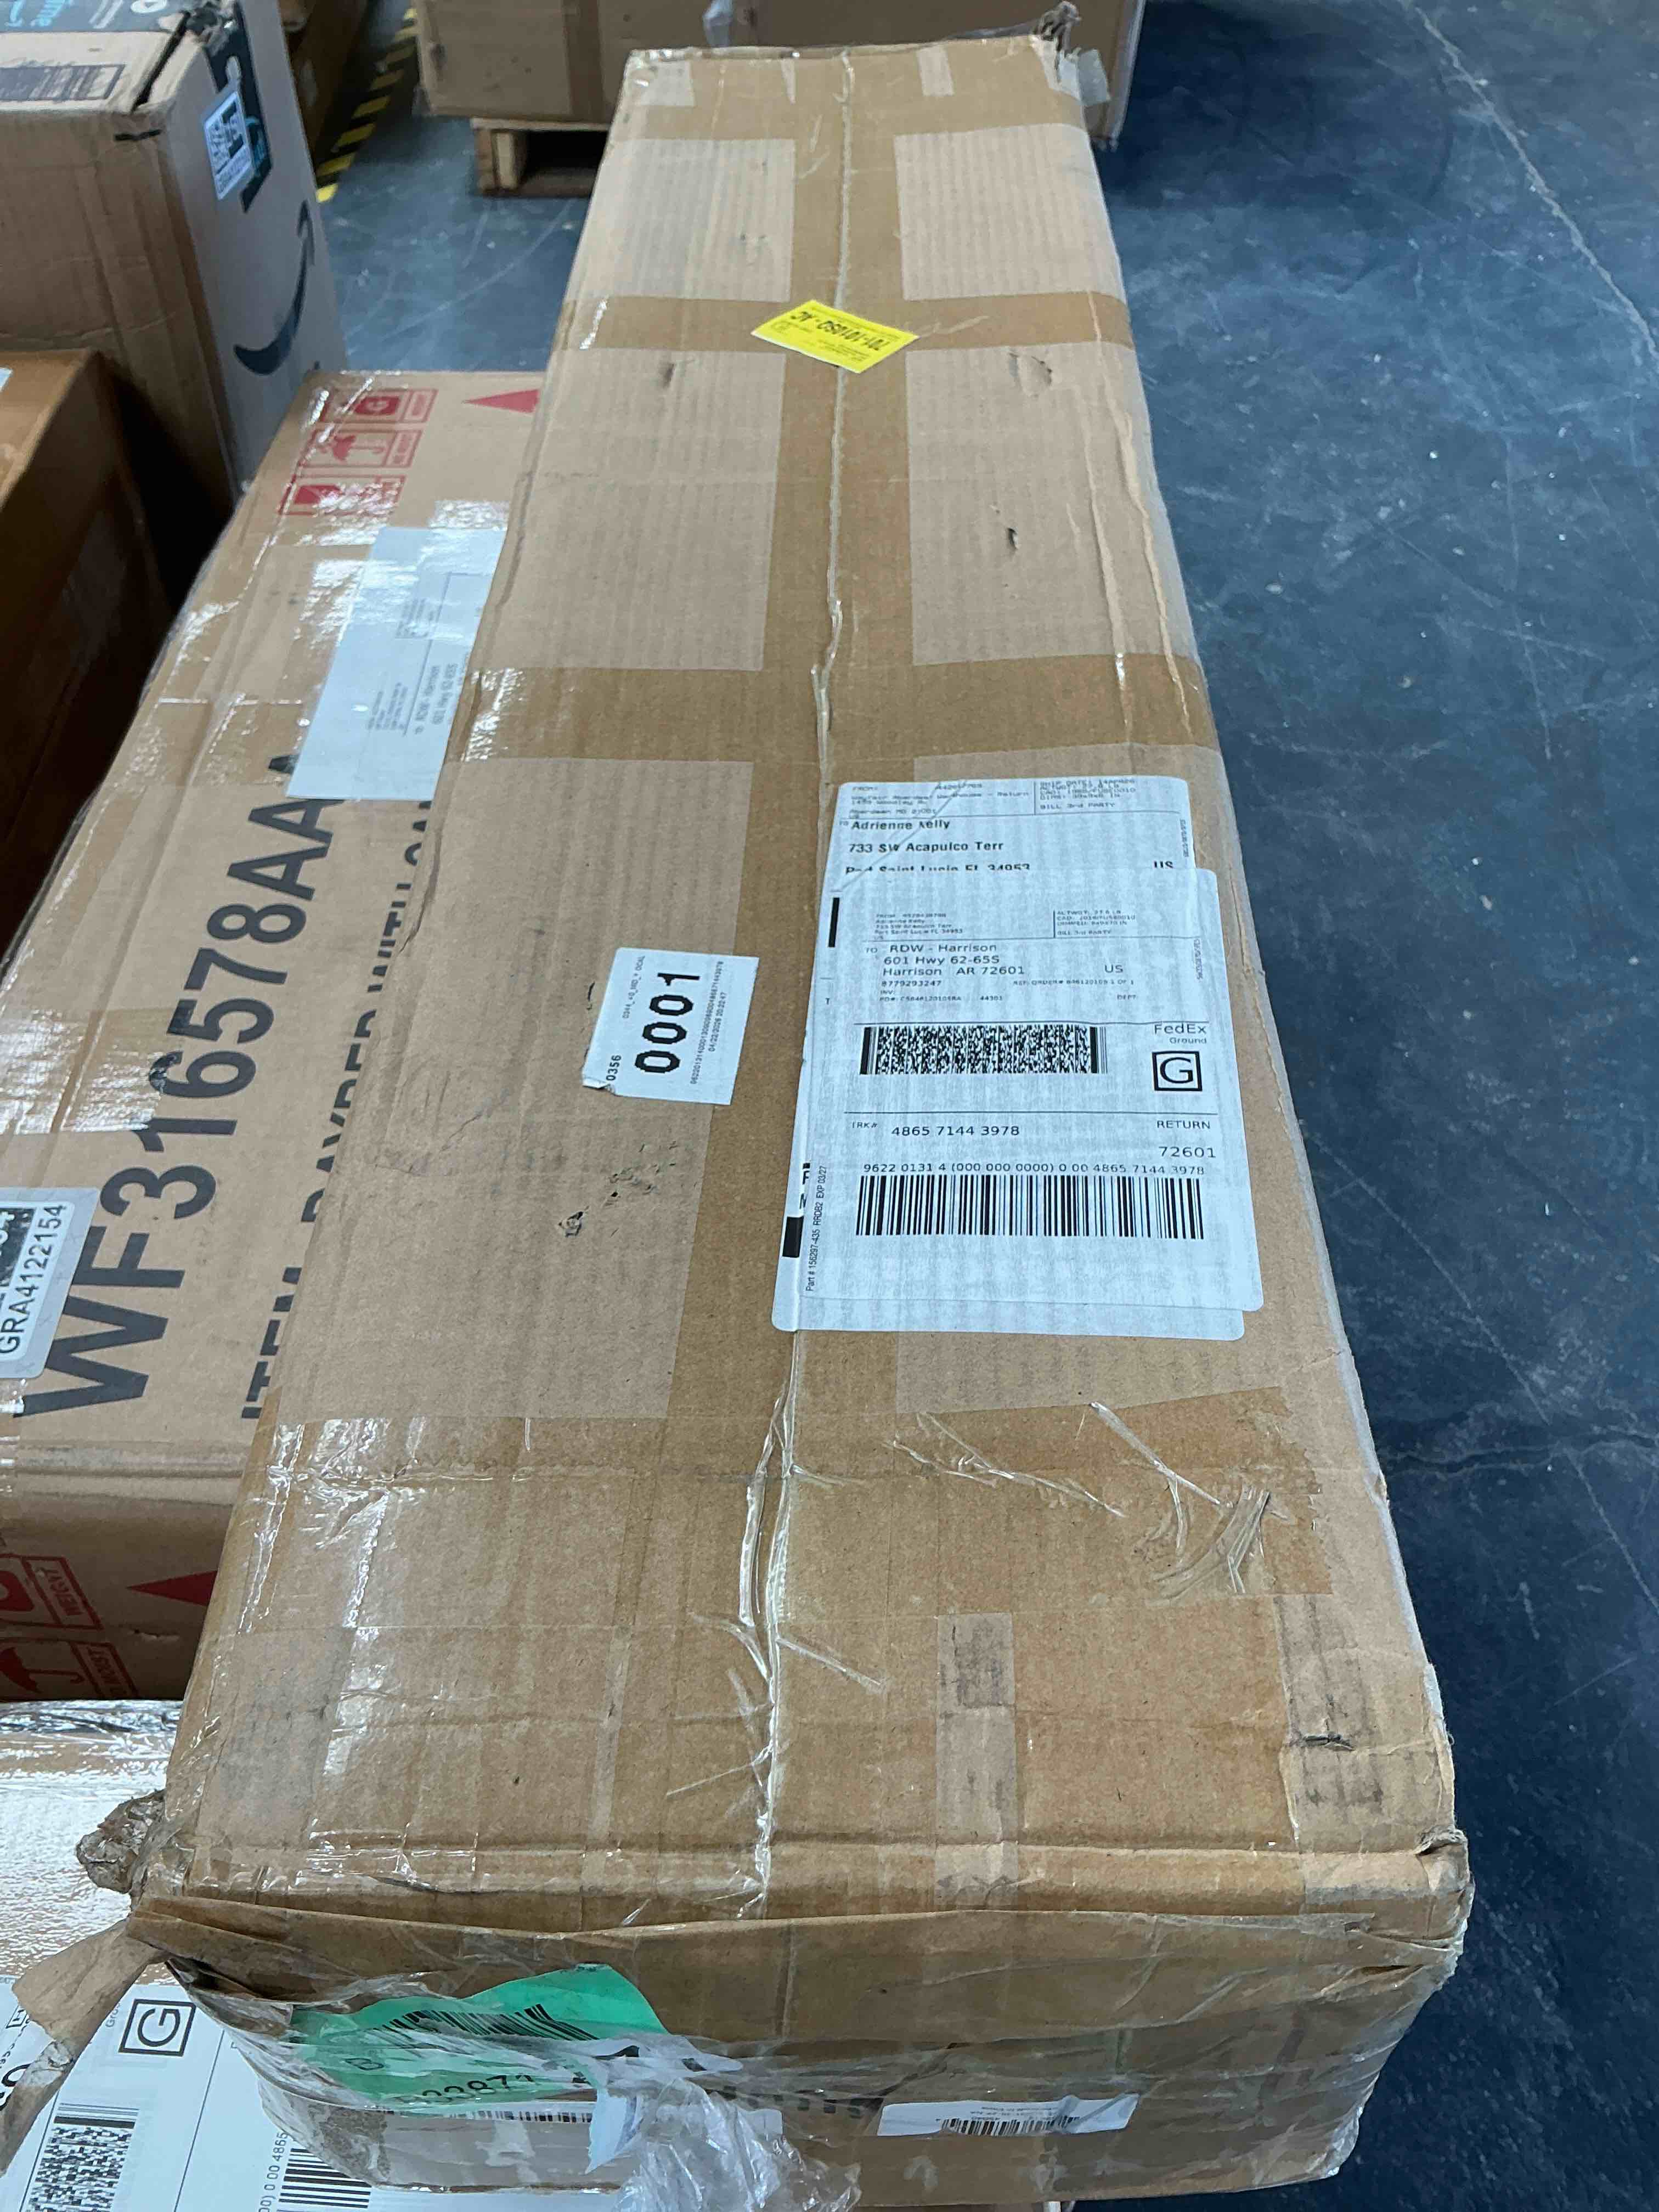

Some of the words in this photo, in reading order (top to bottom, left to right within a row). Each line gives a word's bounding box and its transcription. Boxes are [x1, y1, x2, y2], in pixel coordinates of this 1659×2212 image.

[851, 820, 913, 830] Adrienne
[849, 843, 873, 853] 733
[905, 841, 968, 854] Acapulco
[974, 841, 1004, 851] Terr
[889, 944, 924, 953] RDW
[939, 944, 997, 952] Harrison
[884, 956, 909, 965] 601
[916, 956, 945, 966] Hwy
[883, 967, 942, 977] Harrison
[956, 966, 975, 975] AR
[981, 966, 1025, 975] 72601
[1104, 964, 1124, 974] US
[635, 972, 701, 1074] 0001
[1154, 1023, 1207, 1034] FedEx
[606, 1054, 622, 1081] 0356
[13, 753, 345, 1417] WF316578AA
[891, 1126, 930, 1136] 4865
[936, 1126, 975, 1136] 7144
[981, 1126, 1020, 1136] 3978
[1156, 1120, 1211, 1129] RETURN
[1158, 1146, 1216, 1158] 72601
[864, 1164, 896, 1172] 9622
[901, 1163, 932, 1172] 0131
[939, 1163, 946, 1171] 4
[951, 1163, 981, 1172] (000
[986, 1163, 1011, 1171] 000
[1015, 1163, 1054, 1172] 0000)
[1059, 1164, 1067, 1172] 0
[1071, 1163, 1088, 1172] 00
[1093, 1164, 1126, 1173] 4865
[1133, 1165, 1166, 1174] 7144
[1171, 1166, 1205, 1175] 3978
[816, 1183, 824, 1199] EXP
[808, 1229, 820, 1269] 156297-435
[0, 1204, 67, 1354] GRA4122154
[805, 1276, 816, 1291] Part
[267, 2165, 280, 2180] 00
